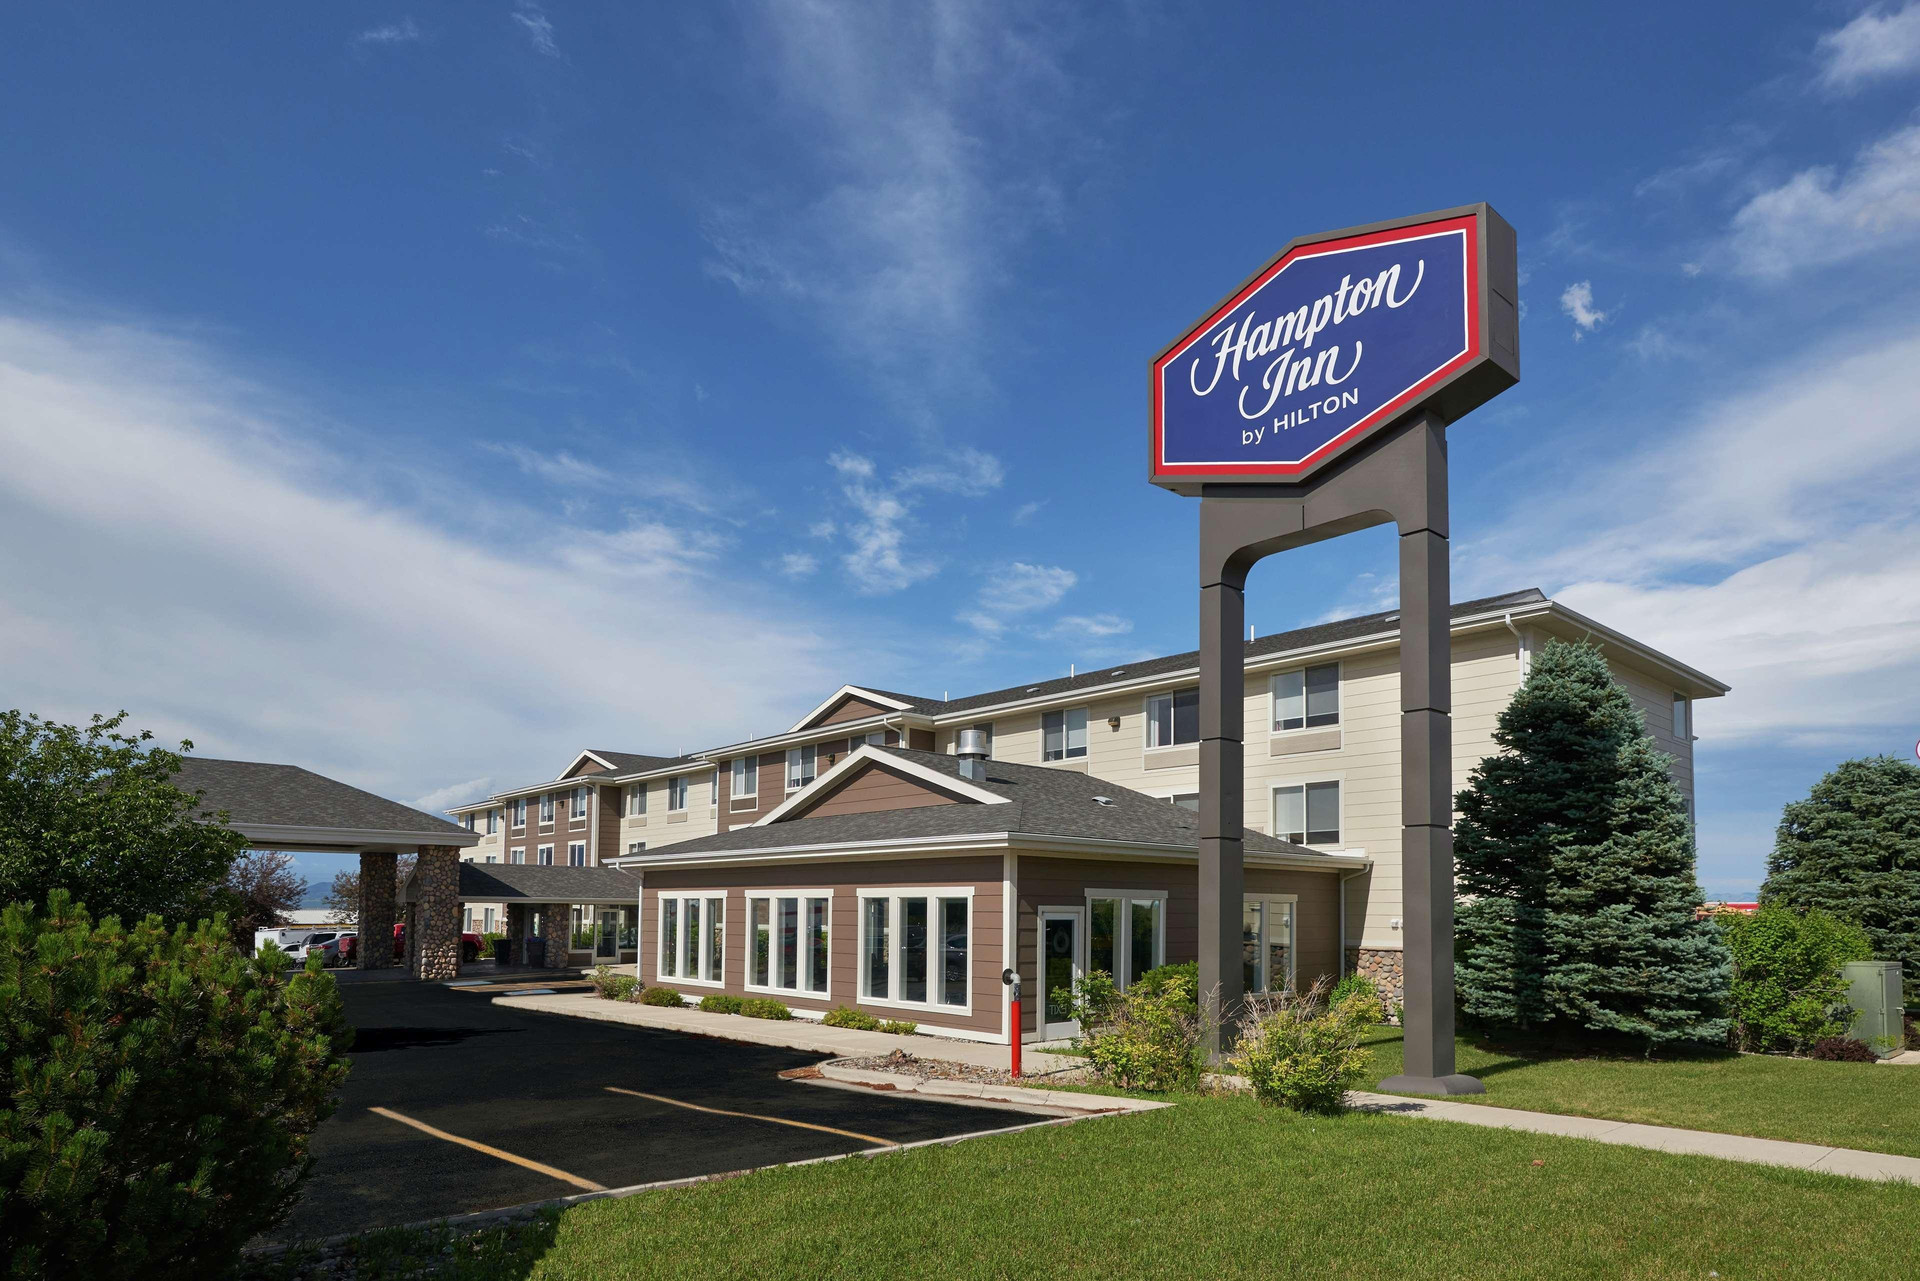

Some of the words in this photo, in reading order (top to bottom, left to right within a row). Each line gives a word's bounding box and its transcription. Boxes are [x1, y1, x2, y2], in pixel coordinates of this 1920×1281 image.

[1191, 259, 1425, 396] Hampton
[1239, 341, 1363, 419] Inn
[1242, 426, 1265, 445] by
[1274, 388, 1359, 434] HILTON
